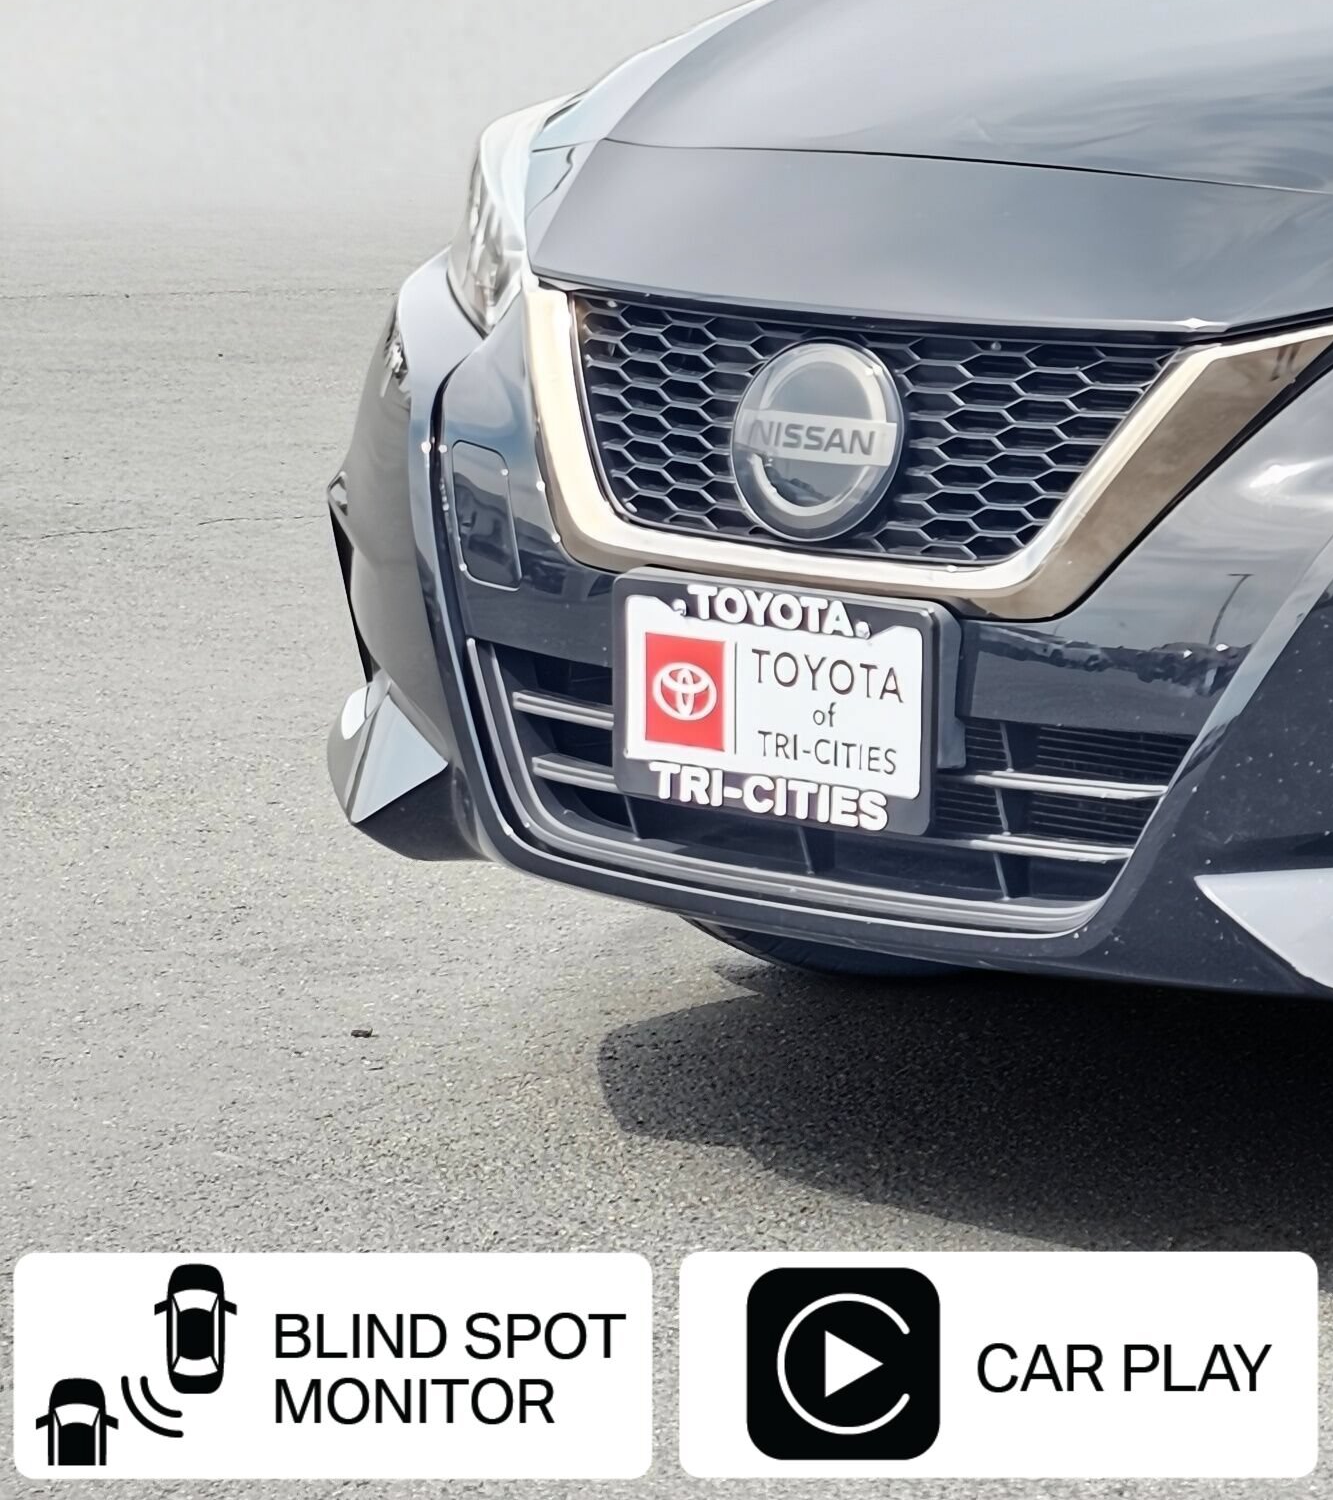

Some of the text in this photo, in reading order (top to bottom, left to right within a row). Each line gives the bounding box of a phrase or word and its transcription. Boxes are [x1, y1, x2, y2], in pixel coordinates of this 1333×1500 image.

[751, 419, 876, 456] NISSAN
[687, 584, 856, 638] TOYOTA
[751, 648, 904, 704] TOYOTA
[812, 701, 836, 728] of
[757, 729, 898, 776] TRI-CITIES
[648, 761, 889, 832] TRI-CITIES
